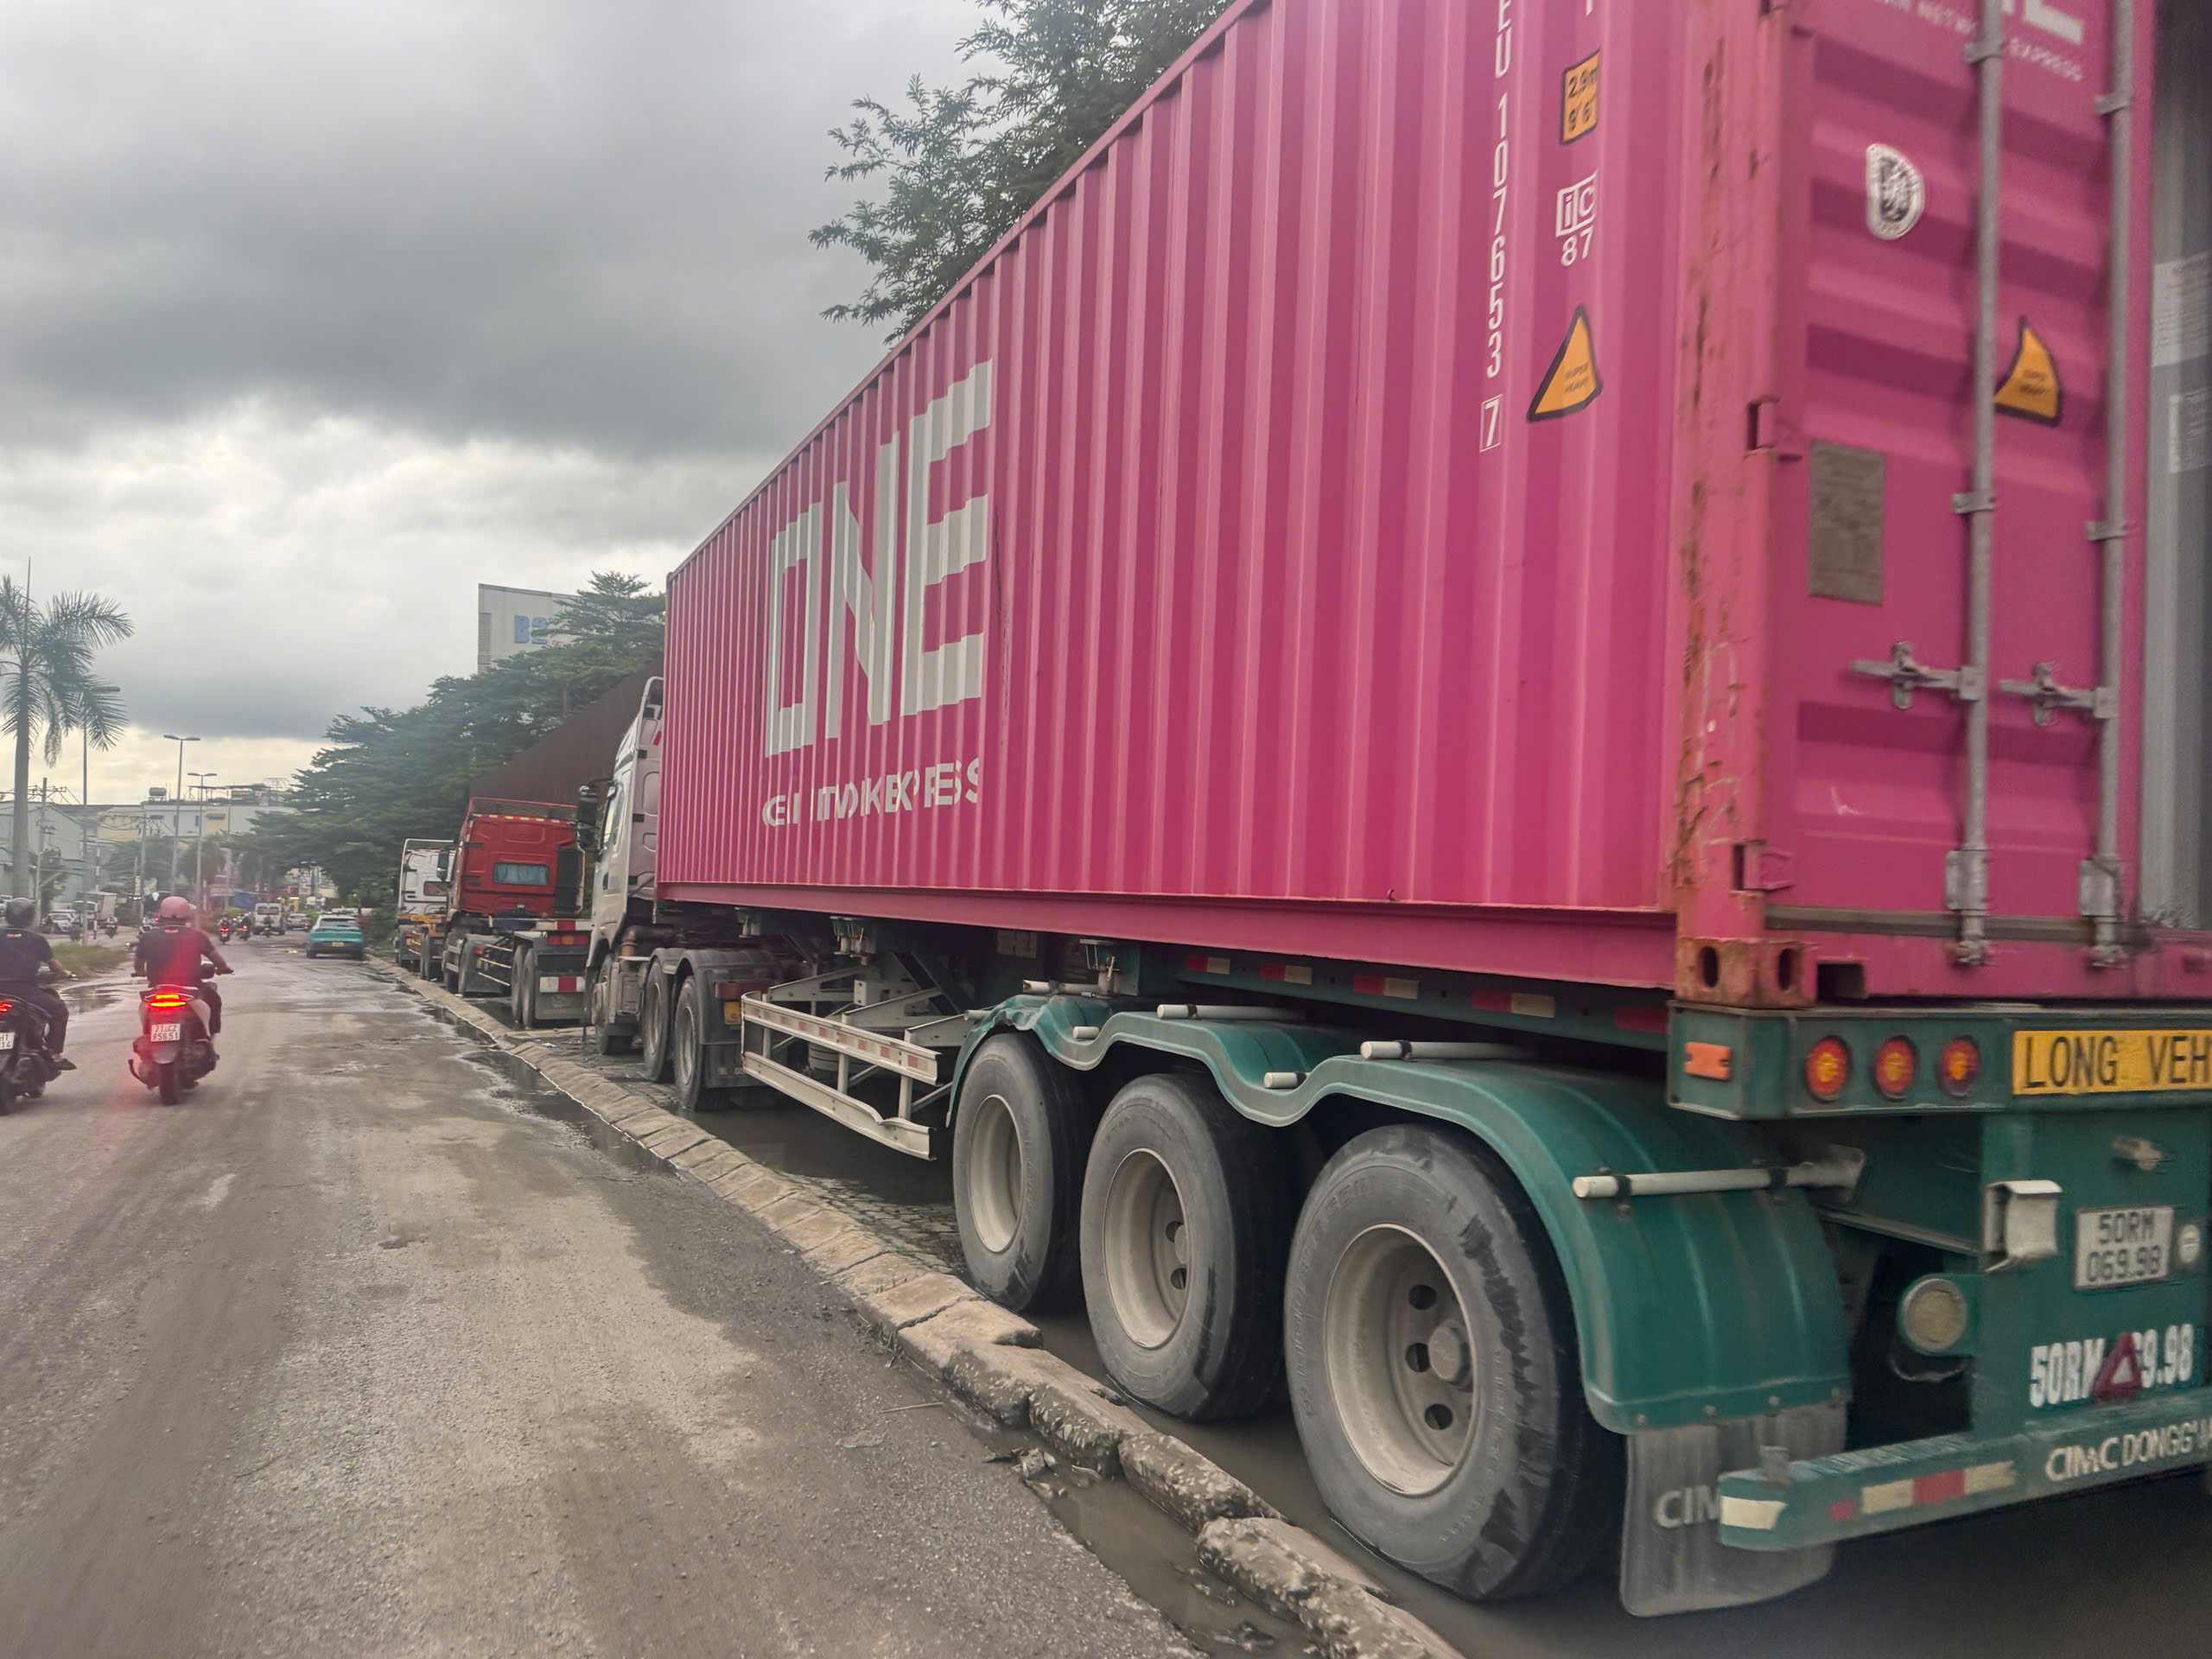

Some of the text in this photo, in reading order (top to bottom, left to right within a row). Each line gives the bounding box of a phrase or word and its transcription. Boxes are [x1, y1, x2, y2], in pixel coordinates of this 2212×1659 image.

[1560, 226, 1593, 266] 87
[765, 358, 993, 758] ONE
[2024, 1034, 2212, 1088] LONG VEH
[1654, 1484, 1721, 1529] CIM
